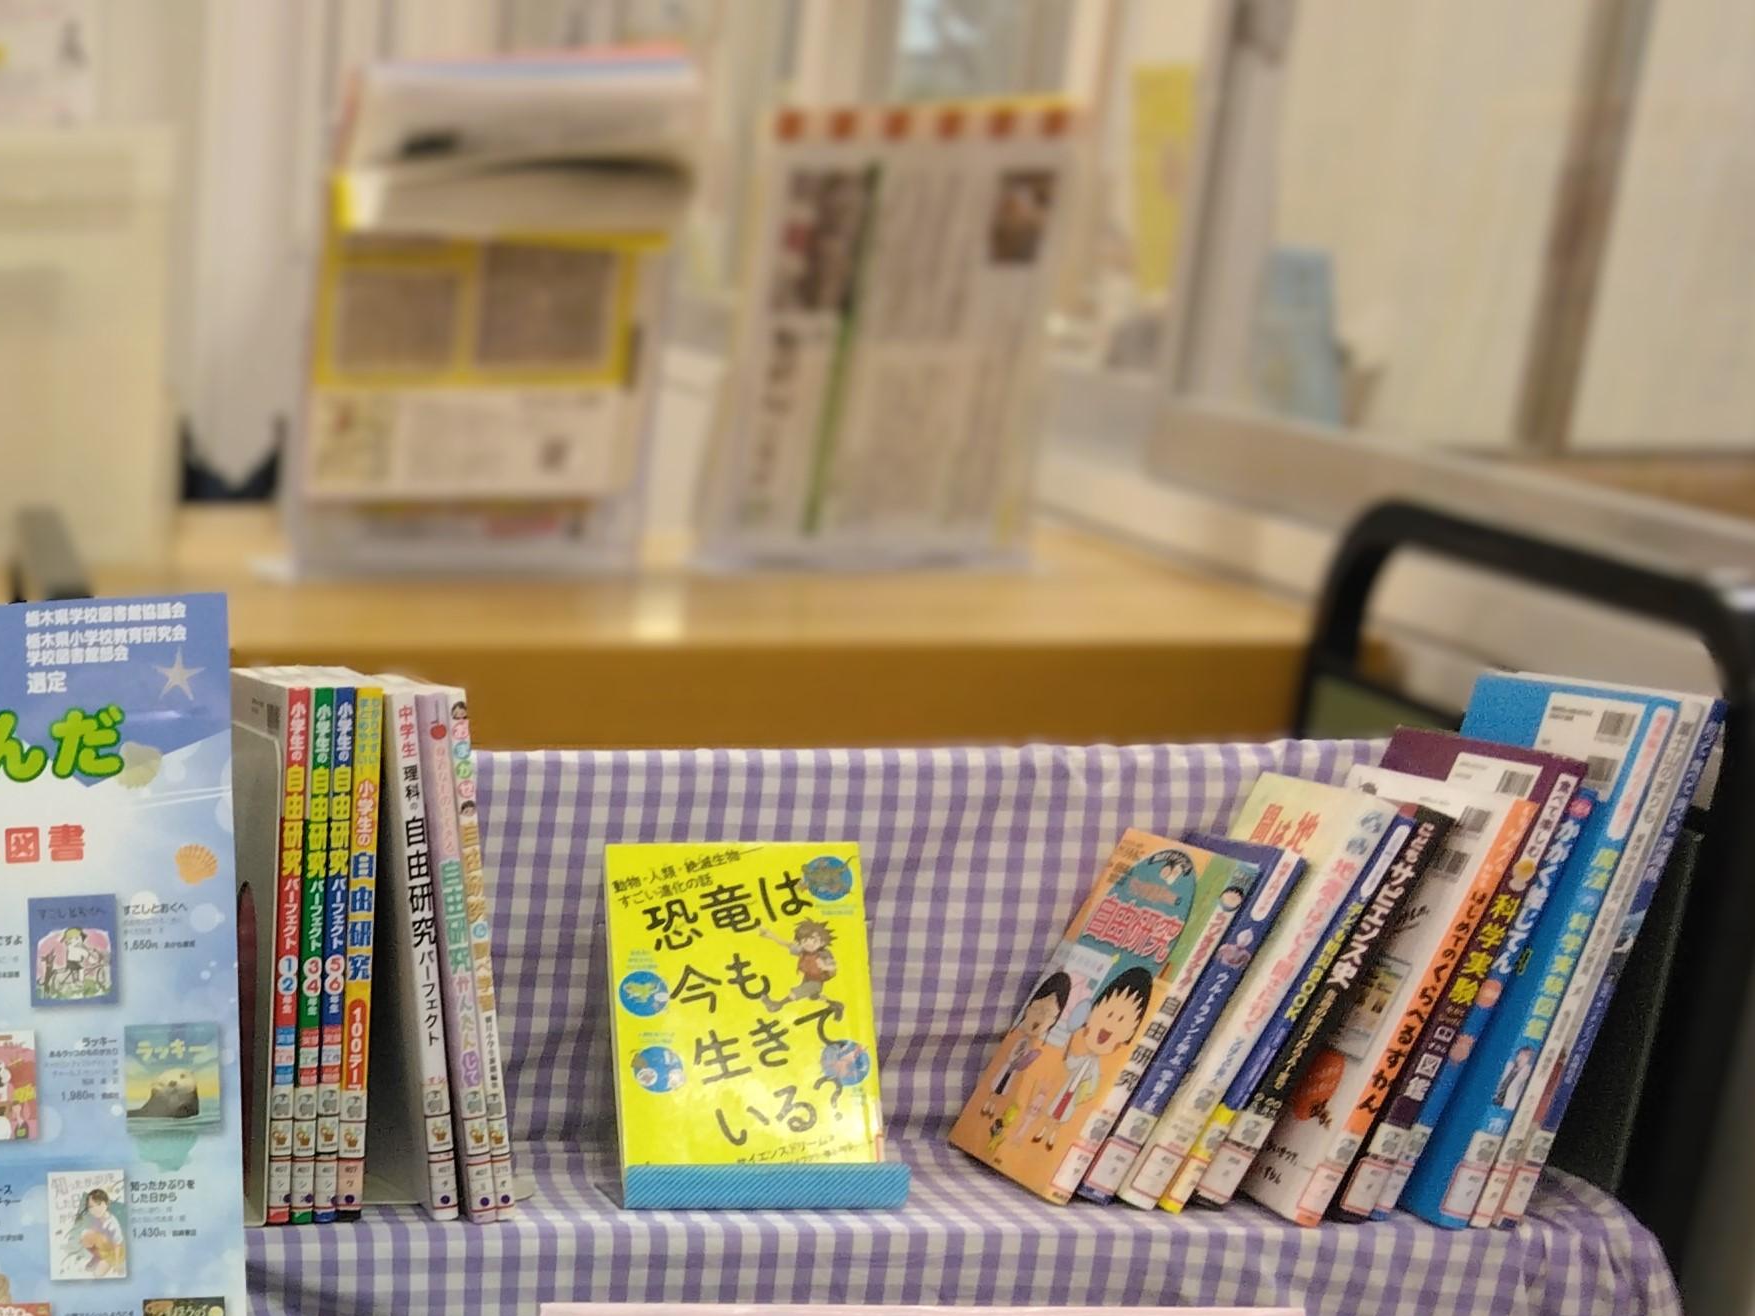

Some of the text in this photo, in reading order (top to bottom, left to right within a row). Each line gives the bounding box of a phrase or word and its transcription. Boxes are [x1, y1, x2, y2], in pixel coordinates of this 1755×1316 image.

[27, 670, 67, 694] 選定
[398, 705, 418, 759] 中学生
[642, 870, 813, 952] 恐竜は
[1082, 893, 1186, 964] 自由研究
[669, 952, 771, 1014] 今も
[1448, 892, 1522, 1008] 科学実験
[694, 1000, 845, 1085] 生きて
[1112, 995, 1182, 1096] 自由研究
